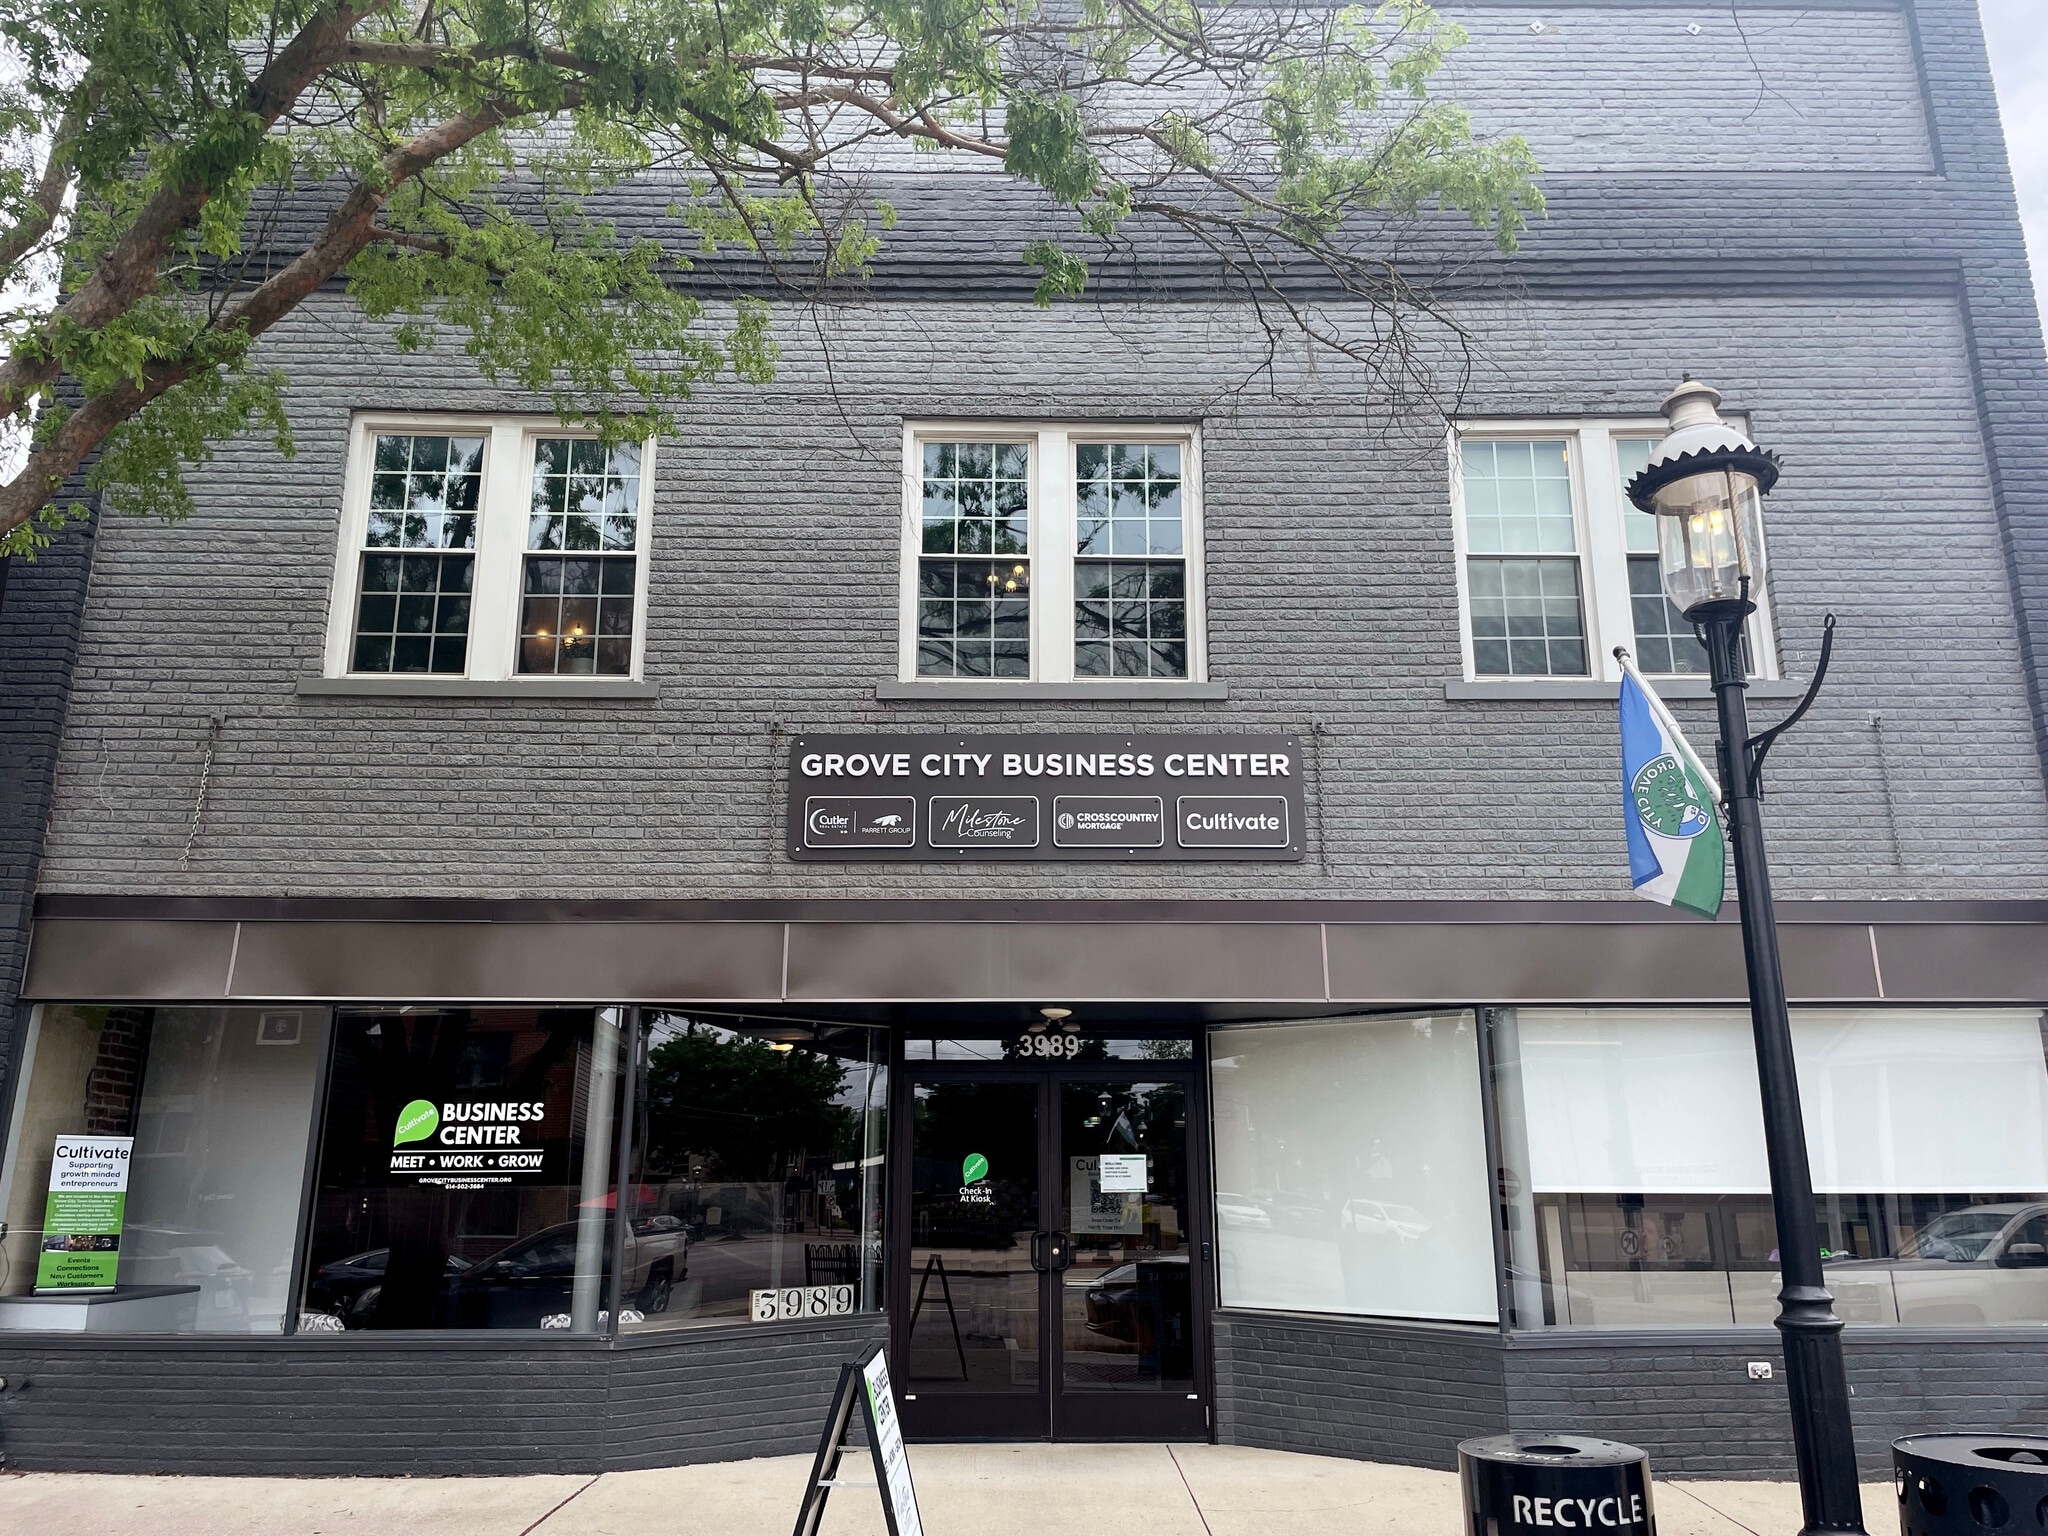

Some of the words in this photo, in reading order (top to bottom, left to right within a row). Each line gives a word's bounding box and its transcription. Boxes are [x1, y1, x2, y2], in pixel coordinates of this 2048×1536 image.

[800, 753, 911, 777] GROVE
[920, 753, 993, 777] CITY
[1003, 753, 1155, 777] BUSINESS
[1164, 753, 1291, 777] CENTER
[819, 815, 849, 825] Cutler
[942, 804, 1026, 837] Milestone
[1077, 813, 1159, 822] CROSSCOUNTRY
[1186, 812, 1280, 831] Cultivate
[966, 828, 1012, 839] Counseling
[1019, 1034, 1079, 1057] 3989
[442, 1102, 544, 1121] BUSINESS
[399, 1109, 434, 1133] Cultivate
[440, 1126, 521, 1145] CENTER
[56, 1145, 129, 1160] Cultivate
[390, 1155, 426, 1168] MEET
[440, 1155, 484, 1168] WORK
[498, 1154, 543, 1168] GROW
[69, 1161, 114, 1170] Supporting
[959, 1186, 993, 1195] Check-In
[960, 1195, 970, 1203] At
[970, 1195, 991, 1203] Kiosk
[1513, 1494, 1644, 1528] RECYCLE
